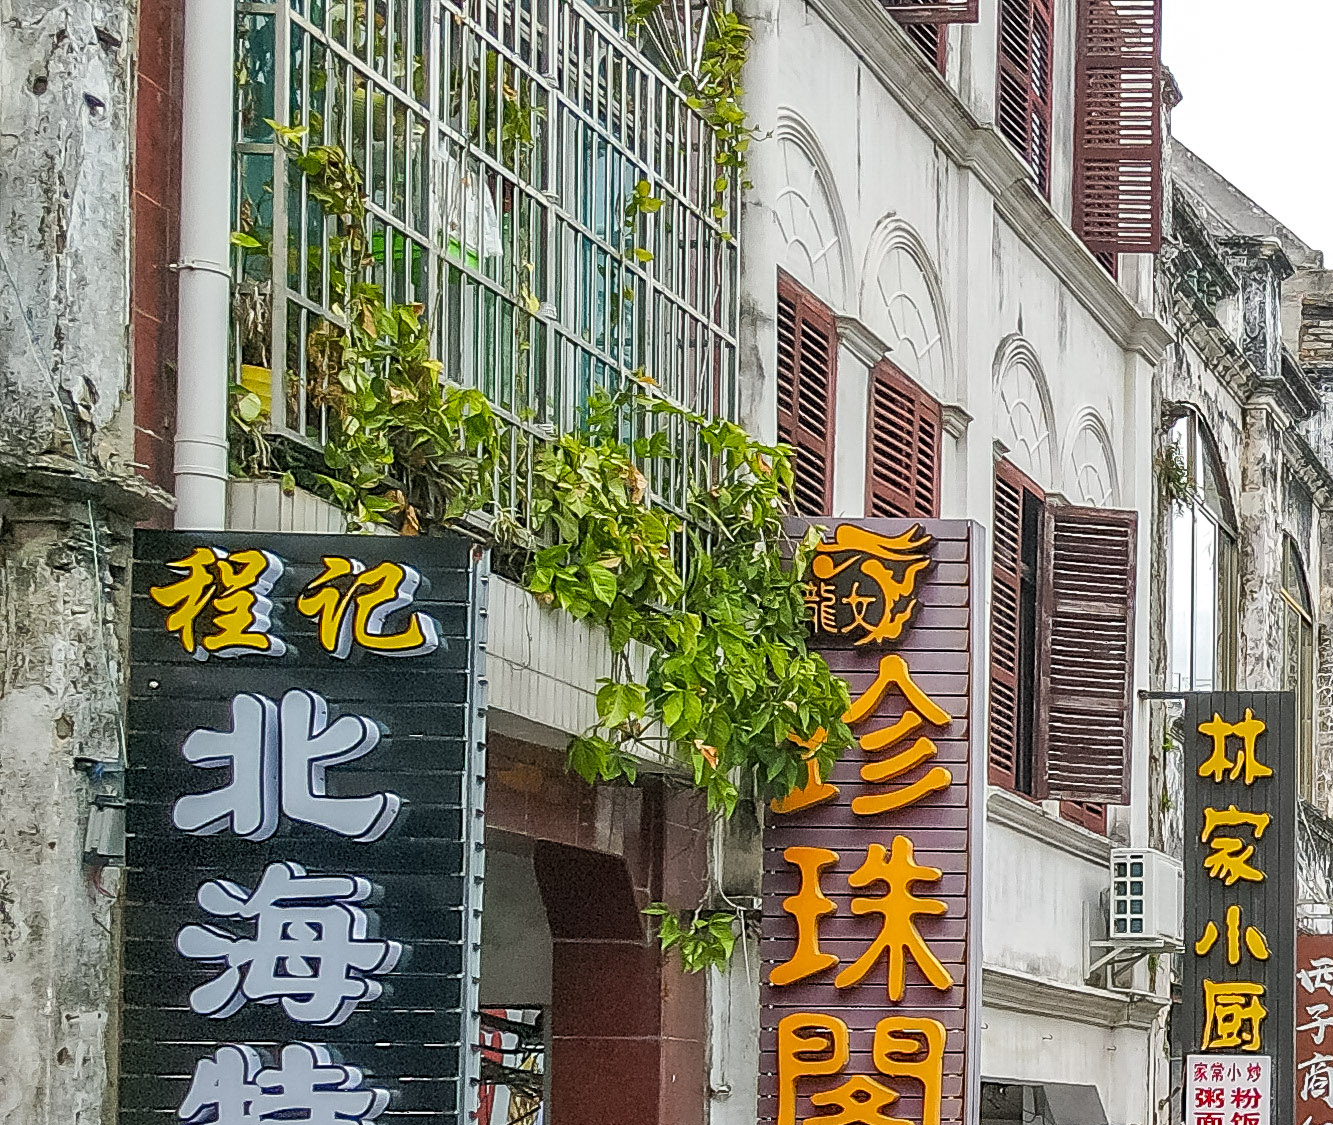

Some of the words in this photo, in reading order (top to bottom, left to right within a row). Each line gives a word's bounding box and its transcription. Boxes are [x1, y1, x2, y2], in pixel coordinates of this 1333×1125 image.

[150, 547, 437, 660] 程记
[1196, 708, 1272, 1052] 林家小厨
[1194, 1062, 1262, 1082] 家常小炒
[1195, 1087, 1262, 1108] 粥粉
